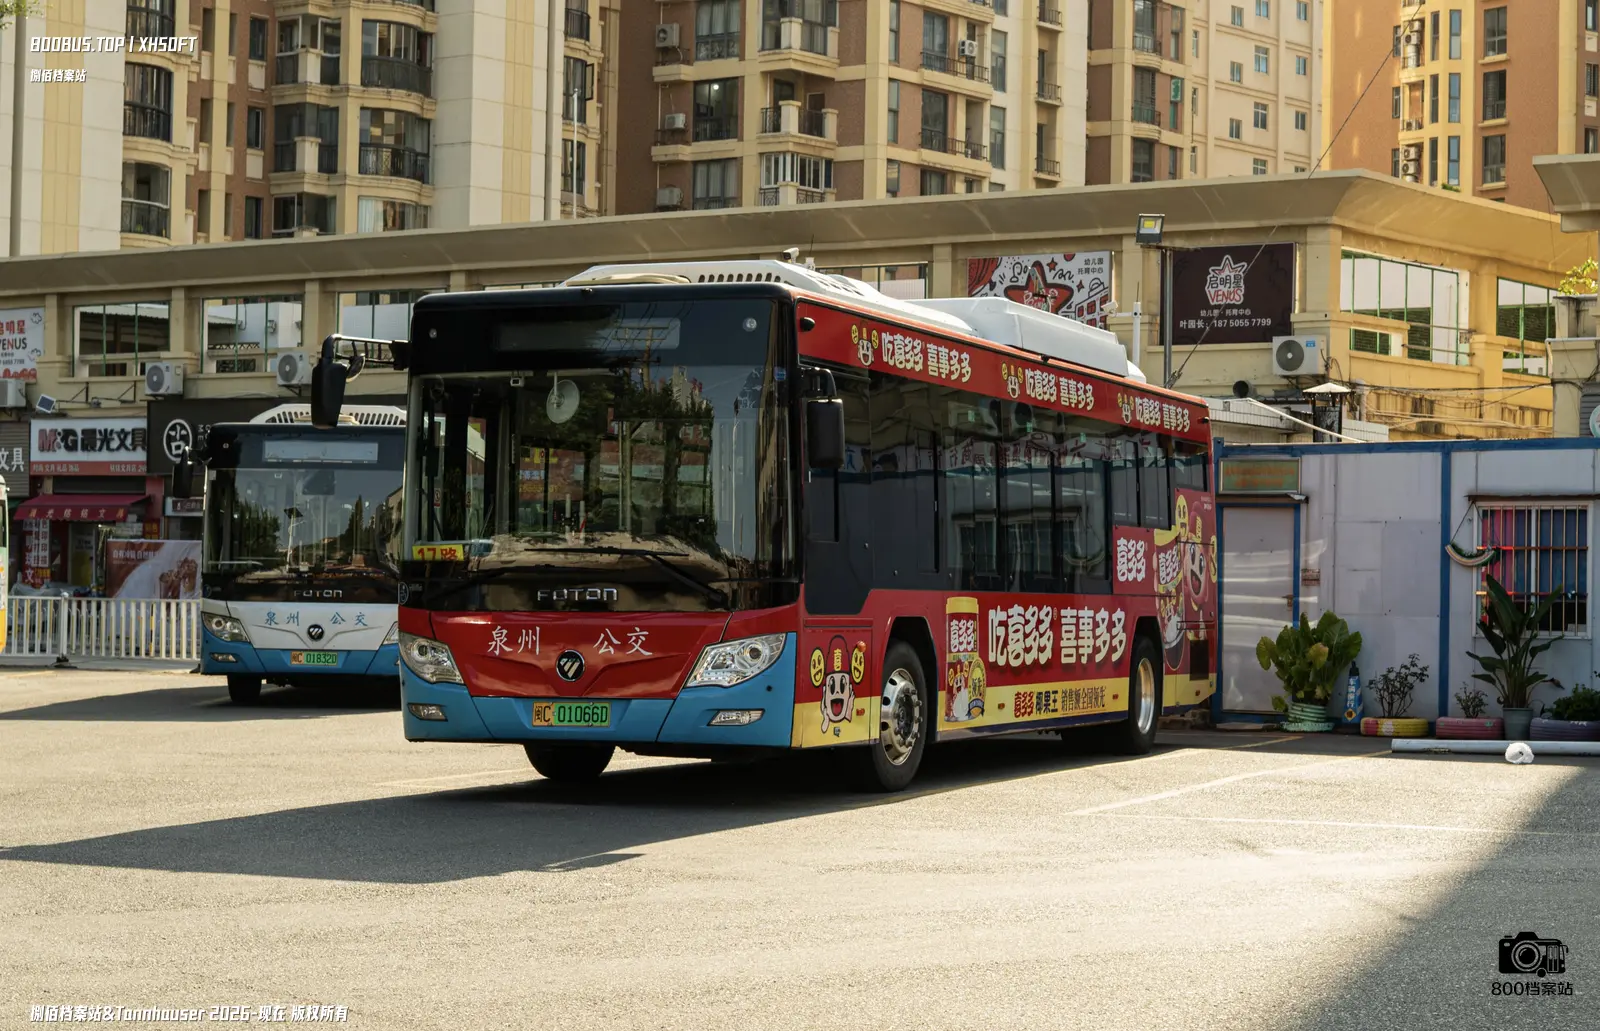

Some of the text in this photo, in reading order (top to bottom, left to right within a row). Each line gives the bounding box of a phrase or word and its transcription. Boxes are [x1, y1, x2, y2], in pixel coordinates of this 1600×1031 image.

[1207, 274, 1243, 290] 启明星
[1208, 288, 1243, 303] VENUS
[1213, 320, 1227, 328] 187
[1229, 319, 1250, 327] 5055
[1251, 318, 1272, 326] 7799
[927, 344, 971, 383] 喜事多多
[1059, 376, 1094, 411] 喜事多多
[1162, 403, 1191, 433] 喜事多多
[81, 427, 147, 452] 晨光文具
[537, 588, 618, 602] FOTON
[265, 611, 368, 627] 泉州 公交
[487, 625, 653, 656] 泉州 公交
[1060, 606, 1127, 665] 喜事多多
[557, 705, 608, 723] 01066D
